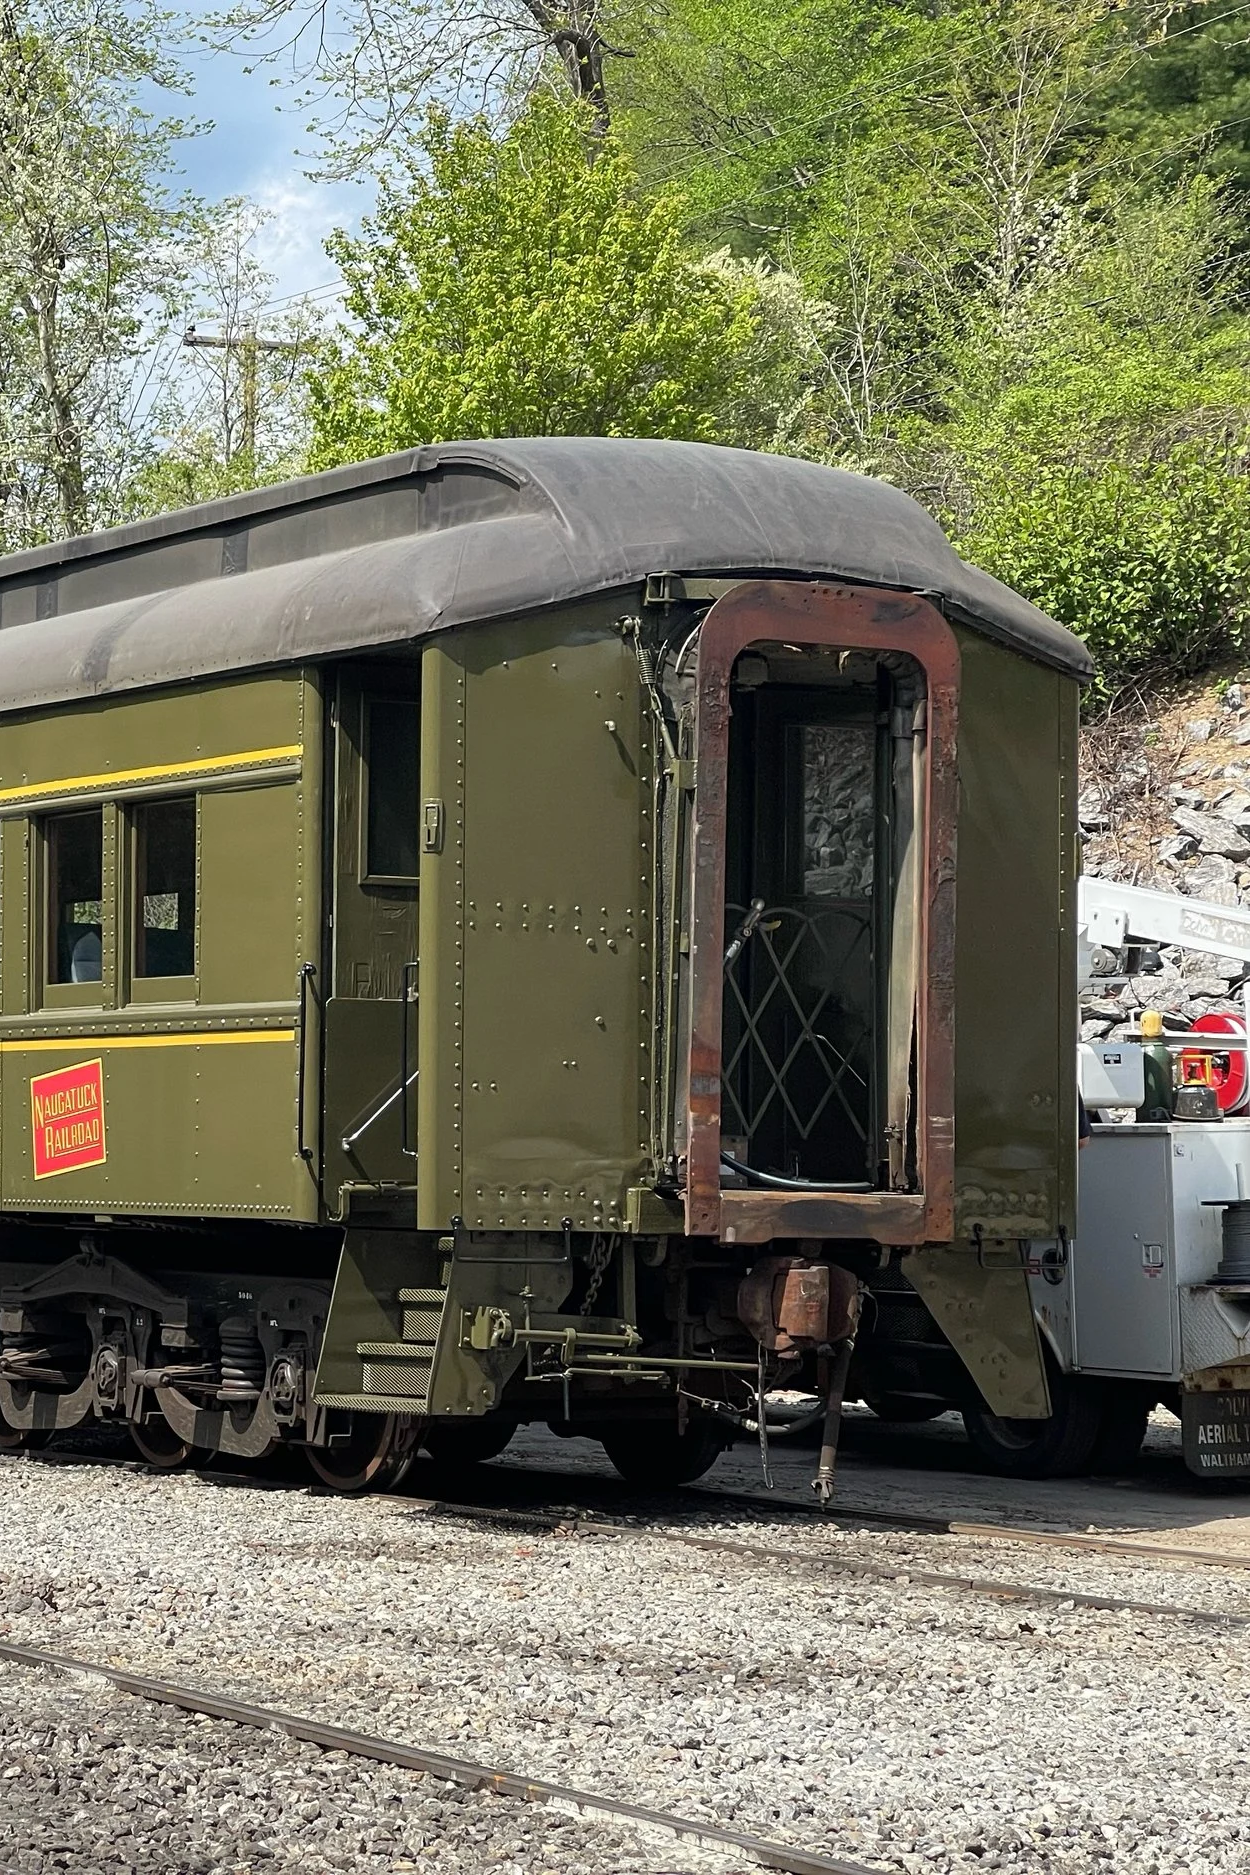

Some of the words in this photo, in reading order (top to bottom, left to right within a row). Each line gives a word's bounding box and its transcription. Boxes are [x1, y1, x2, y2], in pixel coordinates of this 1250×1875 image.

[34, 1083, 98, 1130] NAUGATUCK
[45, 1118, 100, 1160] RAILROAD
[1198, 1423, 1242, 1445] AERIAL
